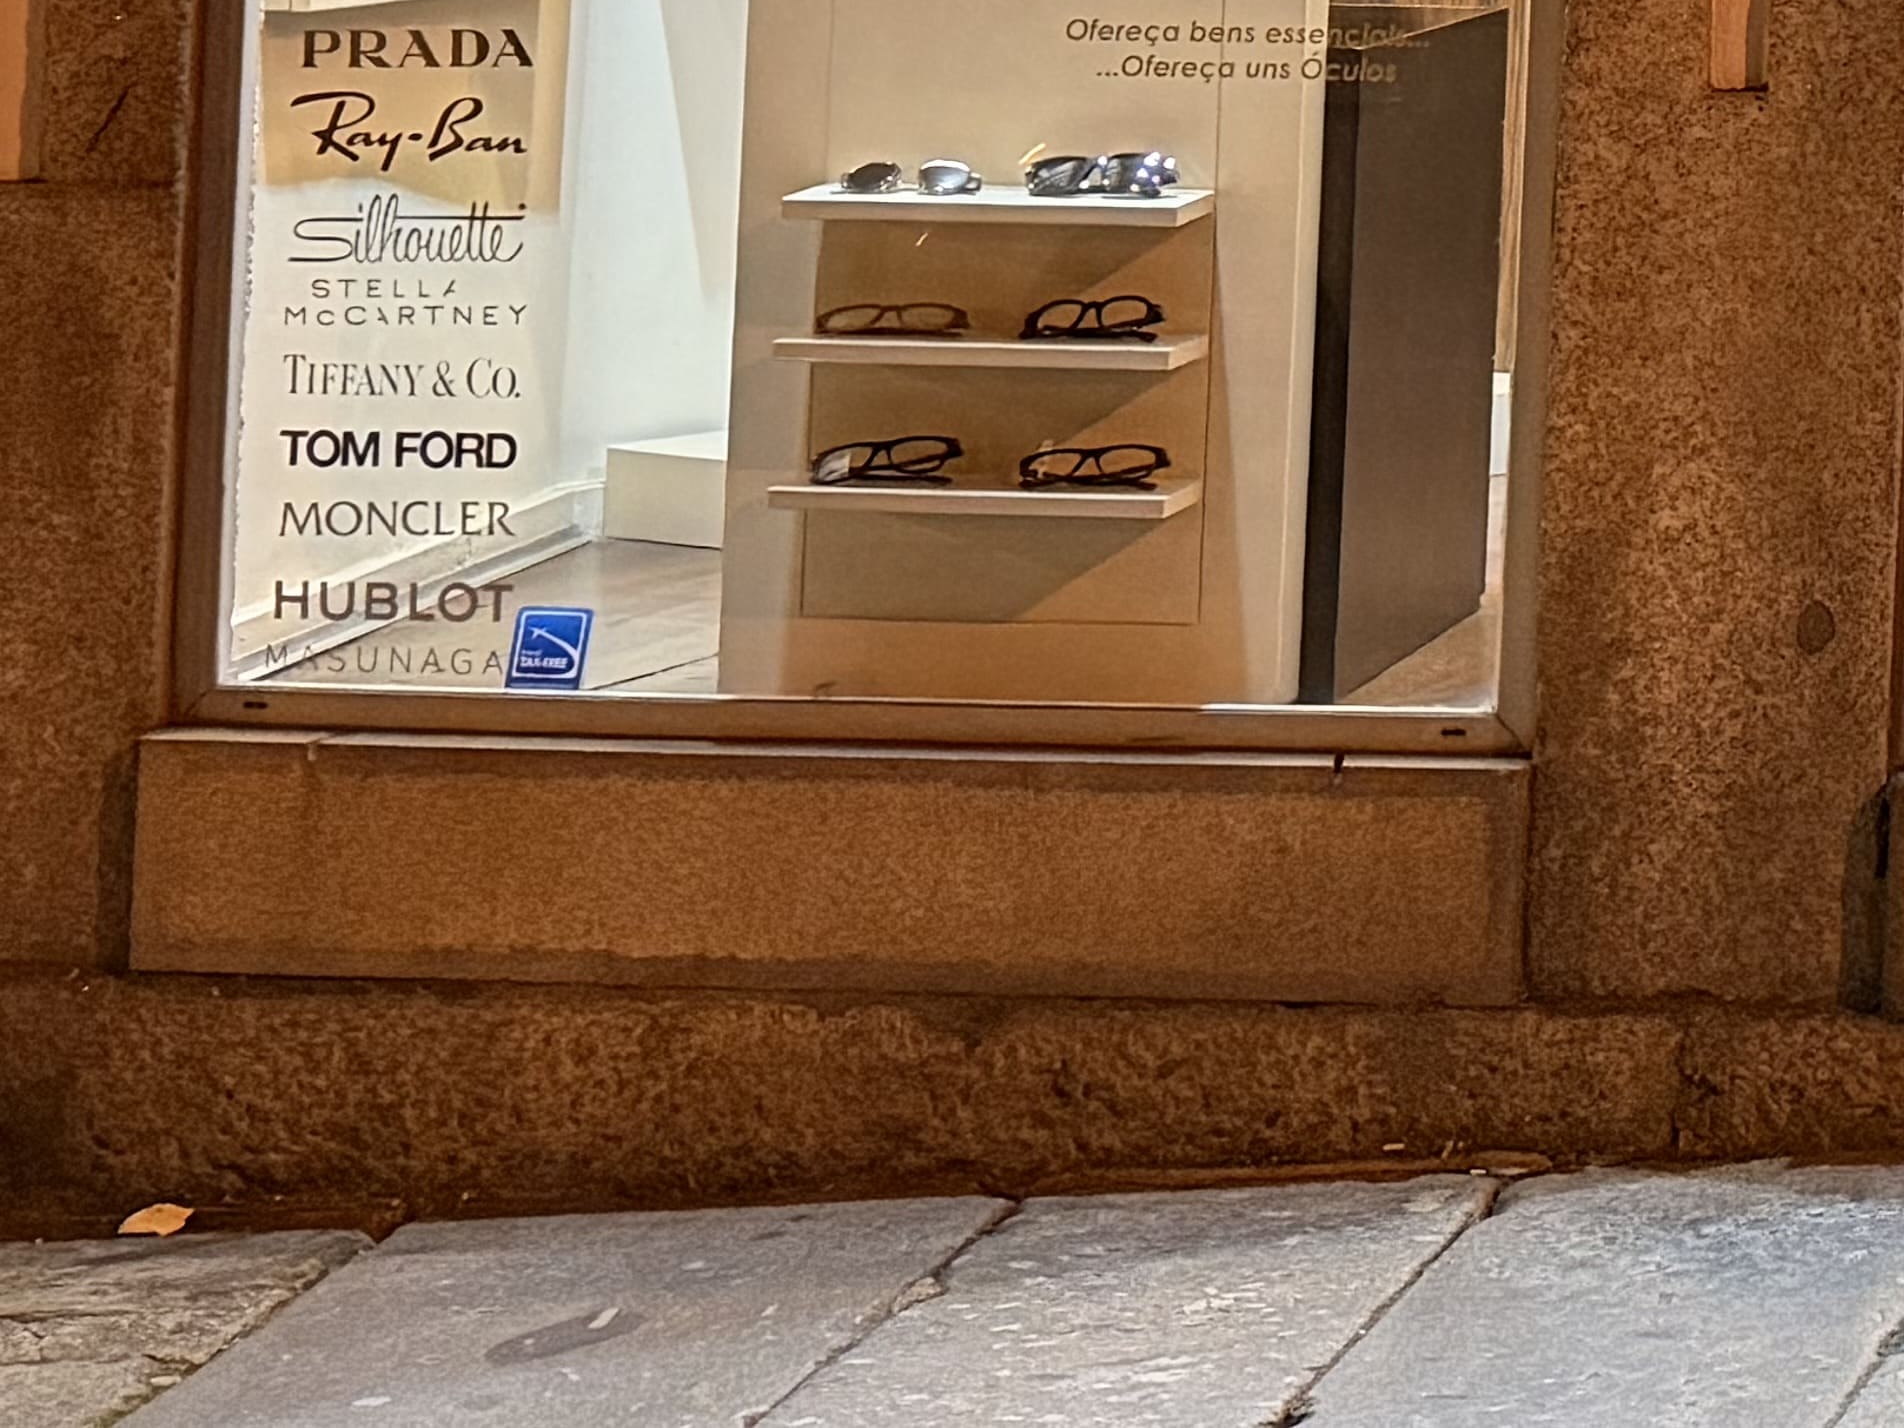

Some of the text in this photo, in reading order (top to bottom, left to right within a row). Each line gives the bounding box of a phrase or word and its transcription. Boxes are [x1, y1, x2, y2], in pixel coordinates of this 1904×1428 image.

[302, 28, 534, 68] PRADA
[1066, 18, 1180, 46] Ofereça
[1190, 20, 1255, 44] bens
[1096, 53, 1397, 82] ...Ofereça uns Óculos
[290, 91, 527, 172] Ray-Ban
[288, 193, 527, 263] Silhouette
[311, 279, 458, 298] STELLA
[283, 354, 424, 397] TIFFANY
[432, 360, 457, 397] &
[280, 429, 517, 469] TOM FORD
[279, 500, 515, 537] MONCLER
[273, 580, 515, 623] HUBLOT
[264, 642, 505, 676] MASUNAGA
